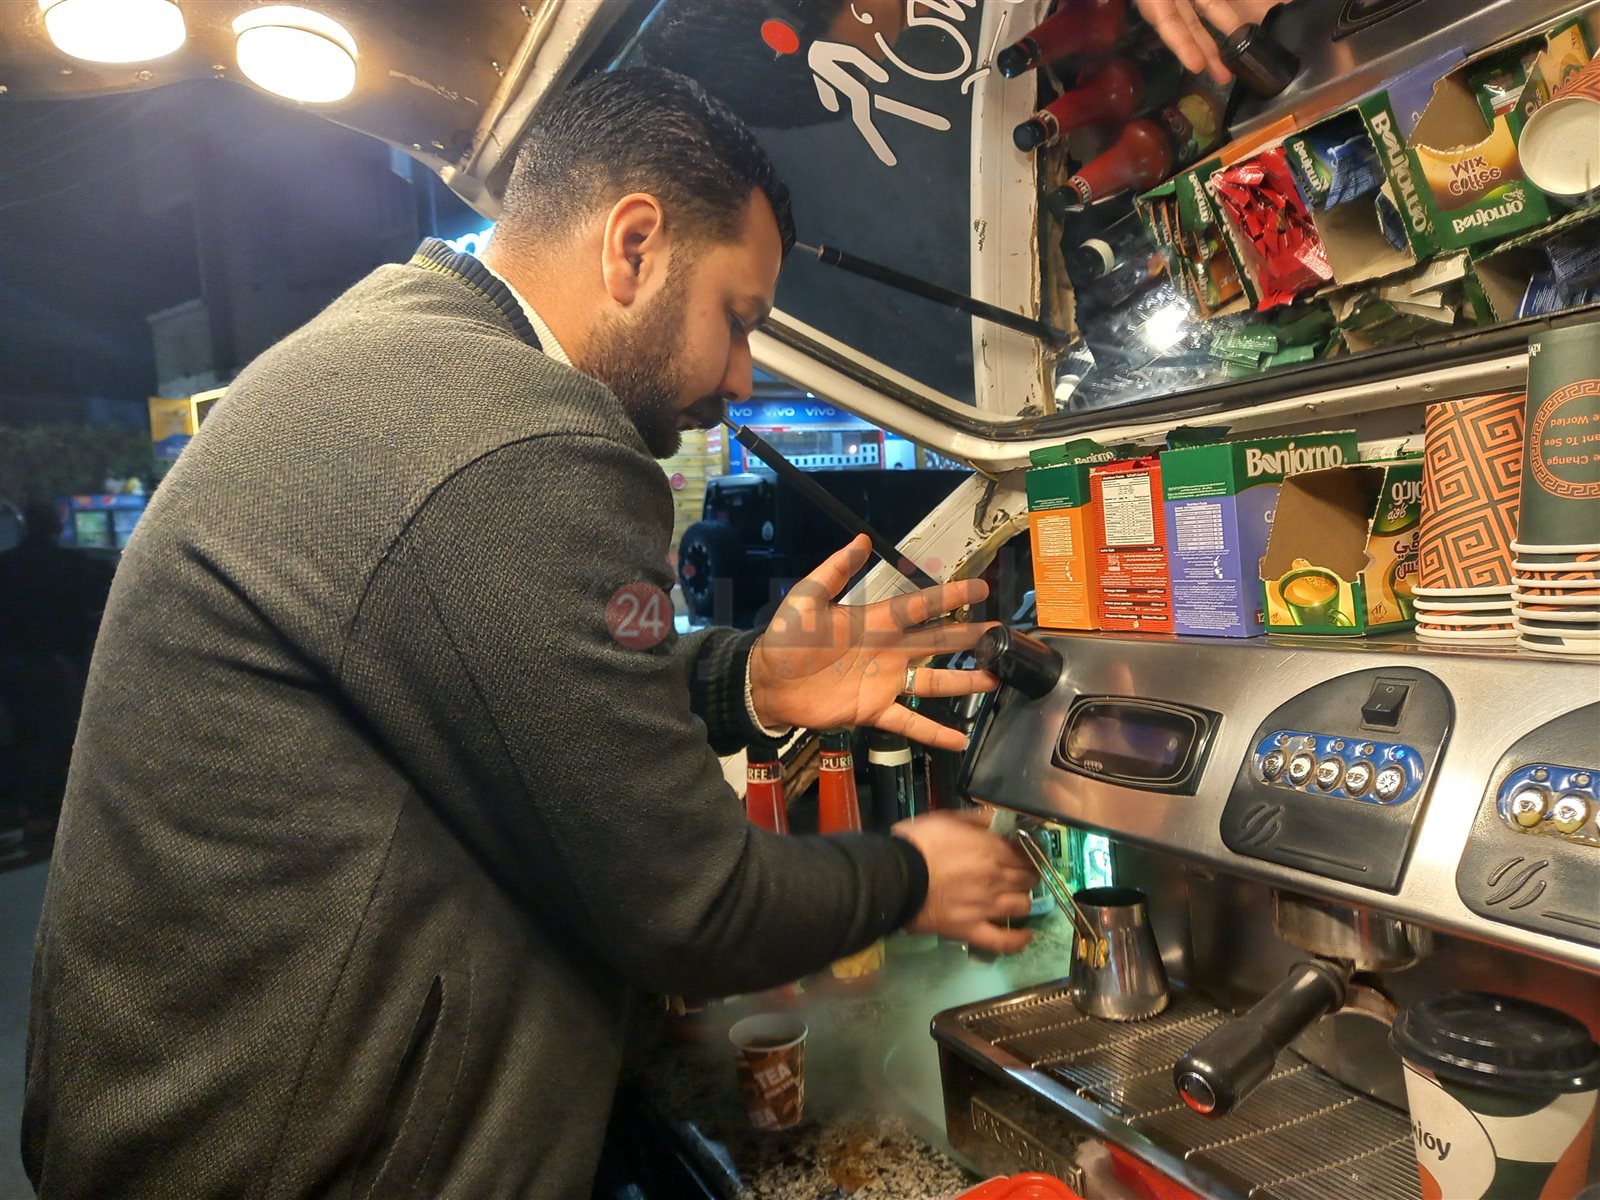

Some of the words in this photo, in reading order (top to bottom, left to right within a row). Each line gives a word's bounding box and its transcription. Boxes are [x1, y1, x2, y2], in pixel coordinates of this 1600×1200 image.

[729, 407, 752, 417] ivo
[763, 407, 796, 417] vivo
[804, 407, 836, 417] vivo
[1544, 437, 1562, 447] See
[1566, 437, 1579, 446] To
[1583, 434, 1600, 444] ant
[1245, 442, 1343, 477] Bonjorno
[1547, 455, 1589, 466] Change
[754, 1063, 792, 1089] TEA
[1412, 1120, 1451, 1160] njoy
